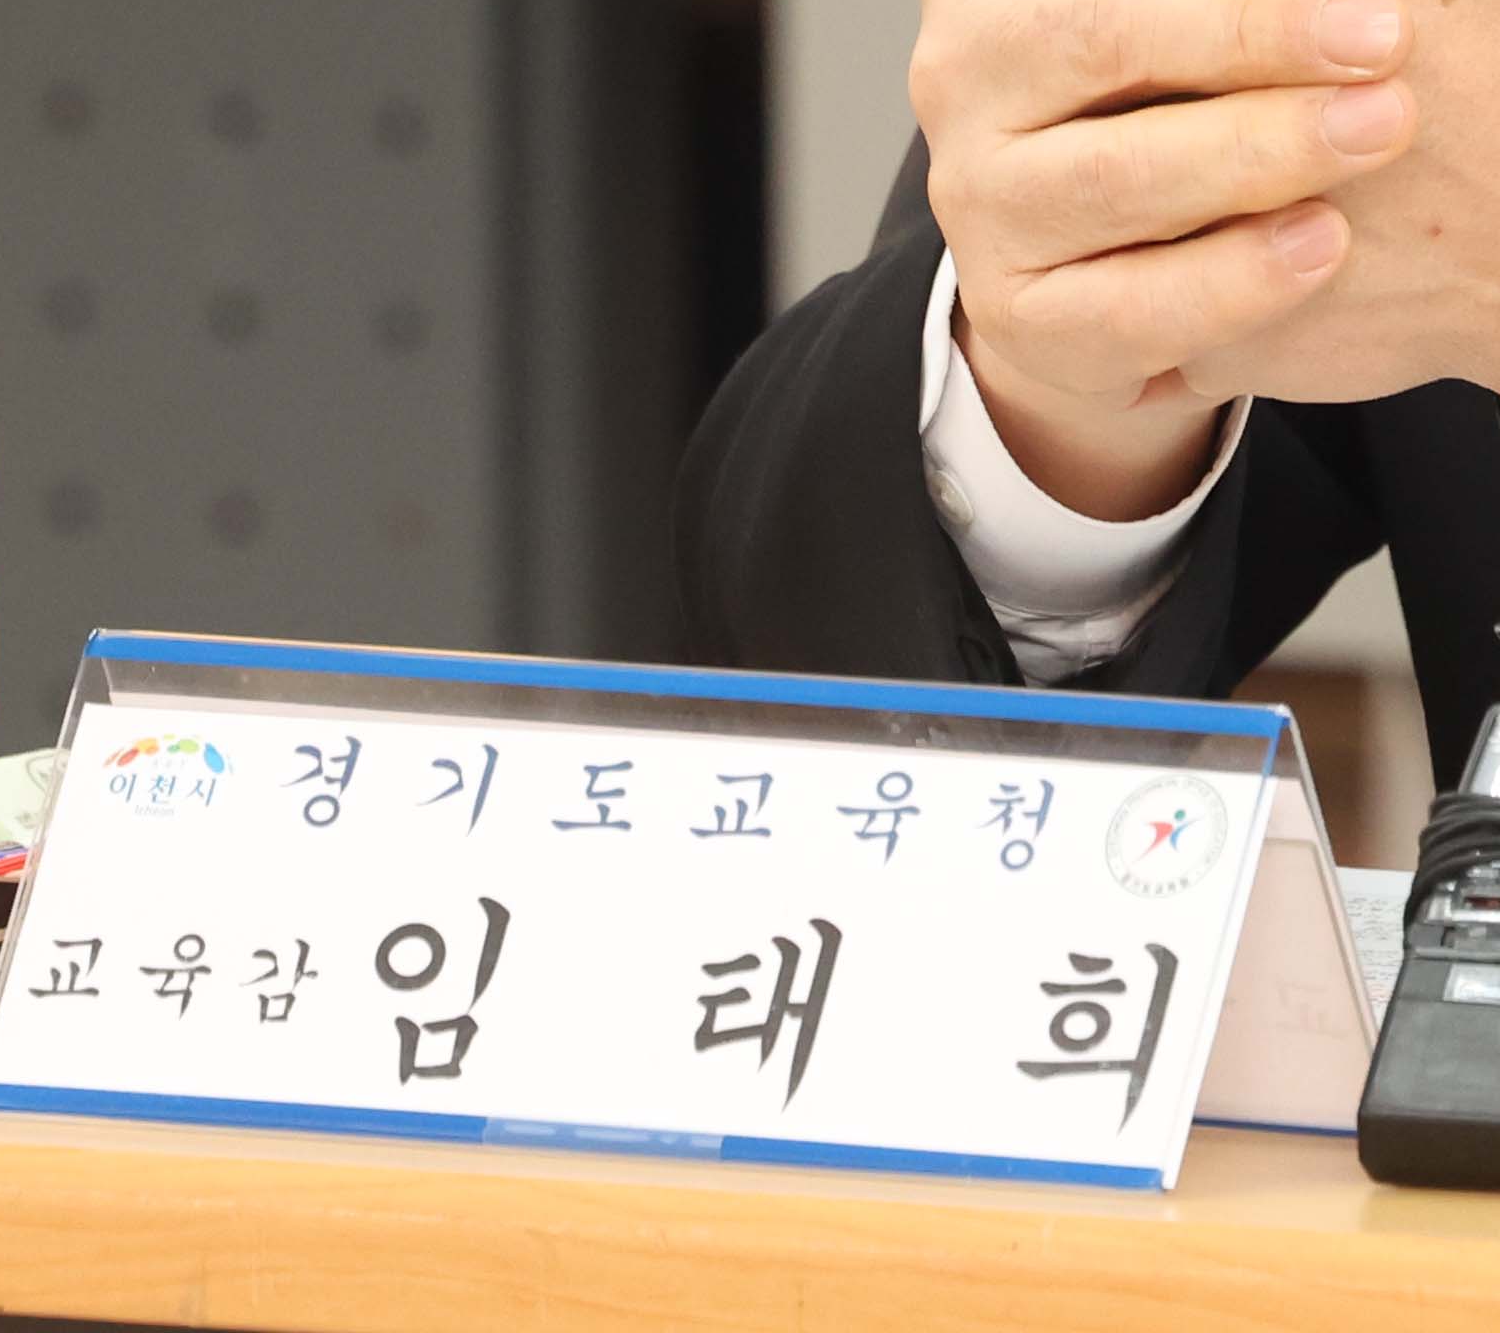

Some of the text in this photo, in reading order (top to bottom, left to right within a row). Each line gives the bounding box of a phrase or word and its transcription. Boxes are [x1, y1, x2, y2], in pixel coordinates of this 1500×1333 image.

[109, 773, 218, 808] 이천시
[282, 734, 1057, 874] 경기도교육청
[26, 932, 320, 1024] 교육감
